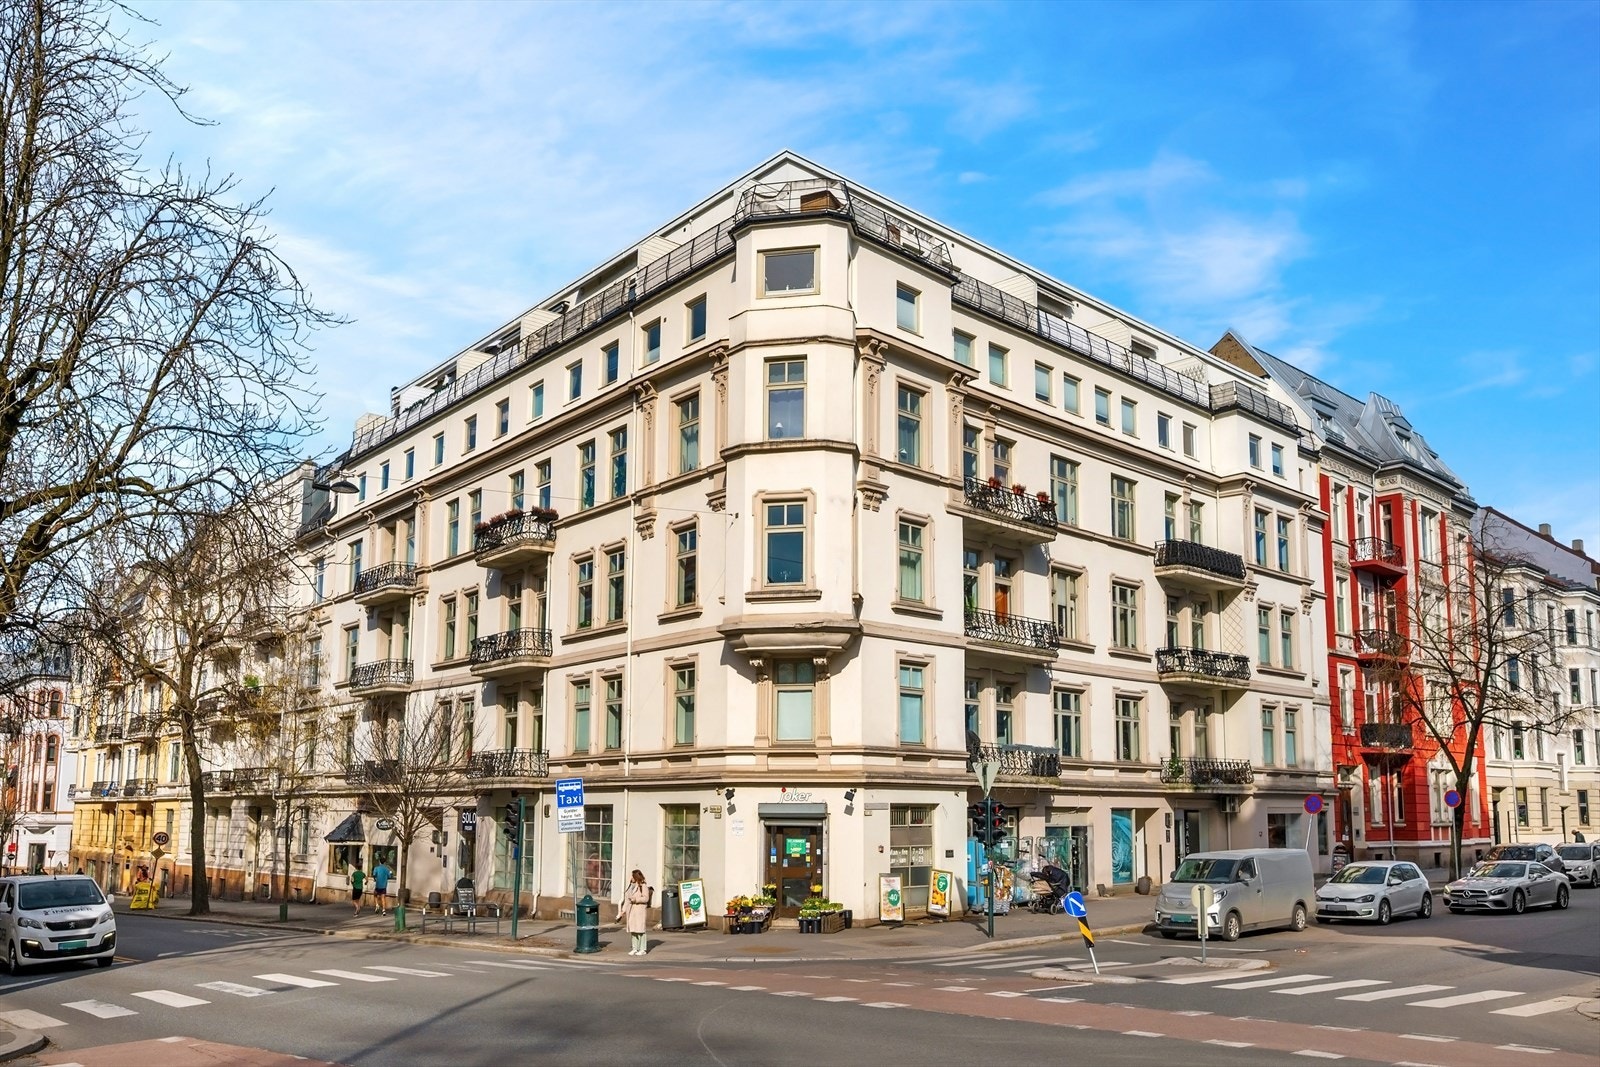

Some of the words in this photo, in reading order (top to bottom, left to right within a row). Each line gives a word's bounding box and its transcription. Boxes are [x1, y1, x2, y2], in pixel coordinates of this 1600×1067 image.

[559, 793, 582, 804] Taxi
[777, 786, 812, 804] joker
[462, 812, 476, 823] SOLO
[156, 834, 167, 842] 40
[52, 906, 93, 914] INSIDER
